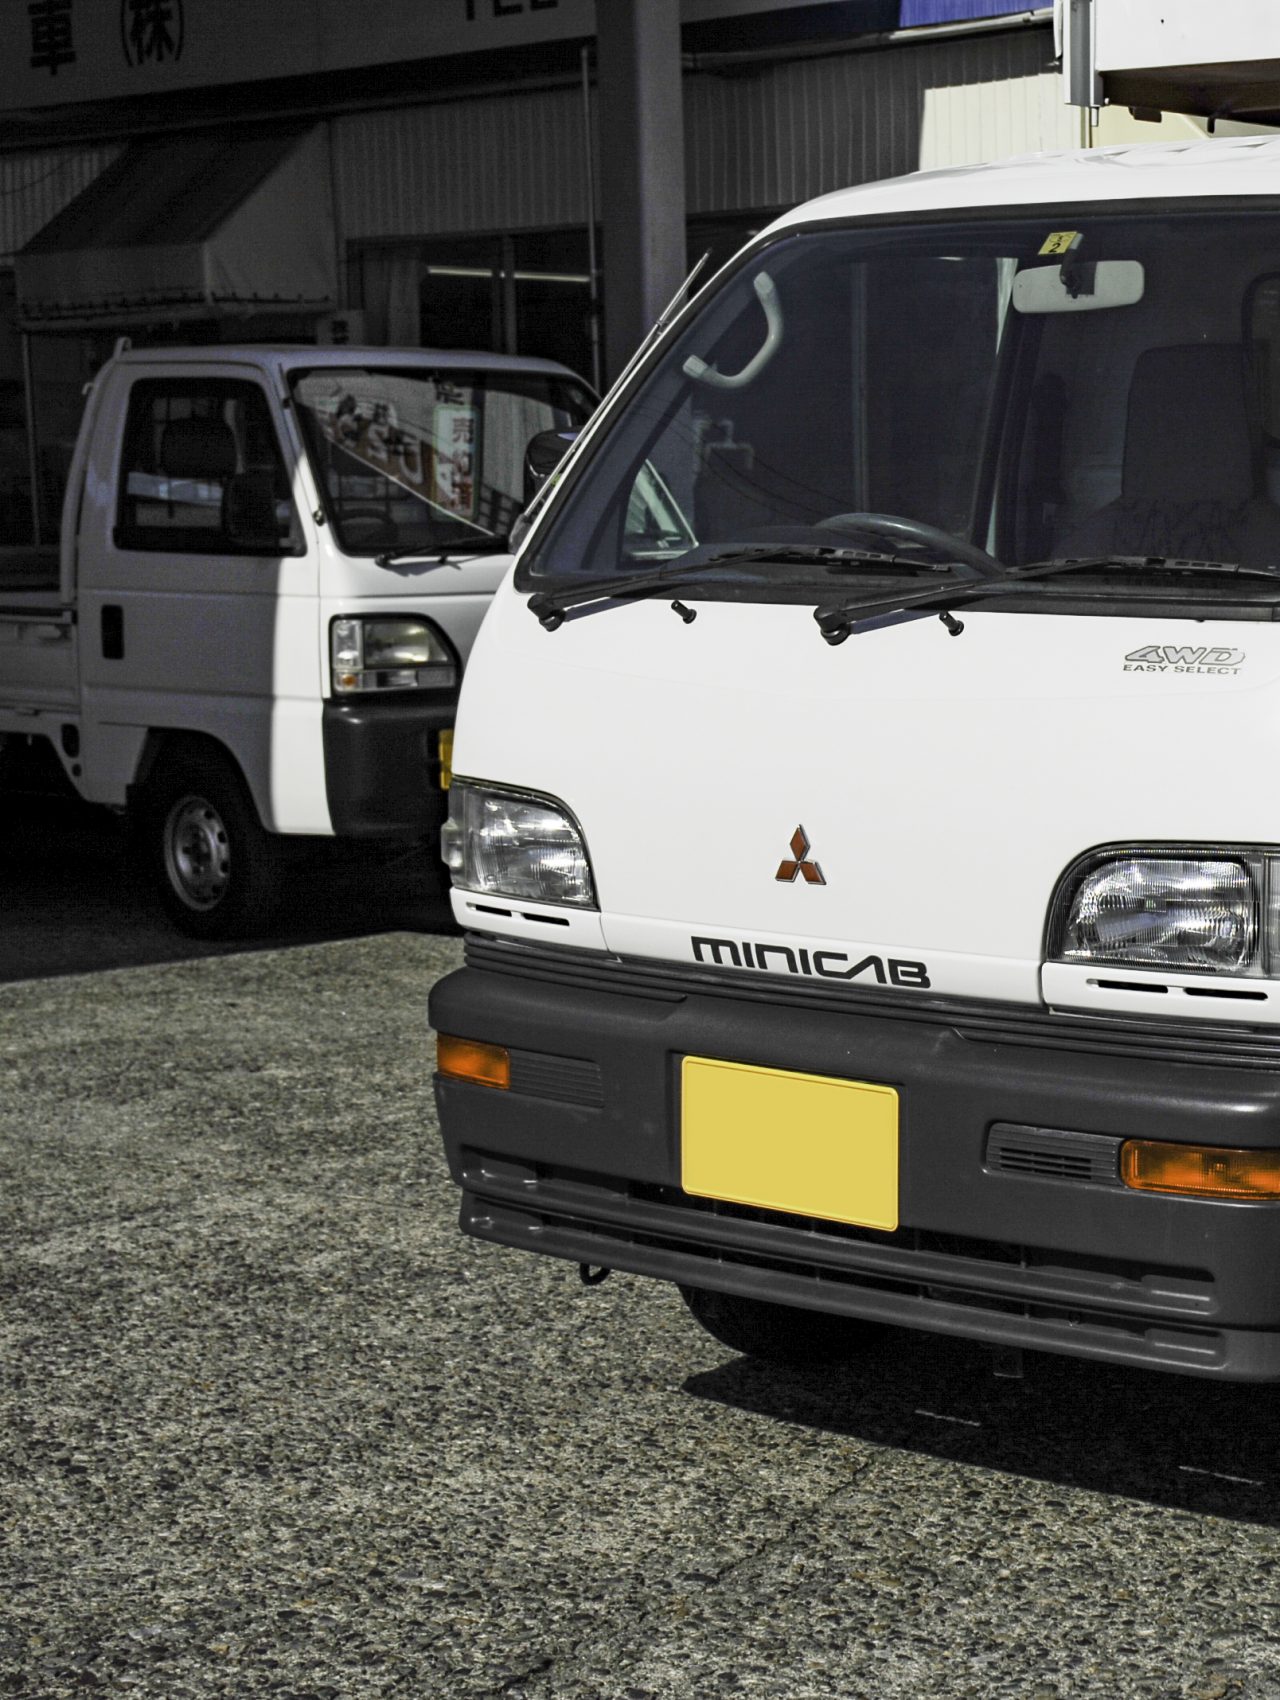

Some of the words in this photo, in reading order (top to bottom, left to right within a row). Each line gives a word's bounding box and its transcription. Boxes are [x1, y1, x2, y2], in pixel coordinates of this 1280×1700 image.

[1124, 645, 1247, 666] 4WD
[1122, 664, 1168, 673] EASY
[1173, 665, 1242, 676] SELECT
[690, 935, 932, 989] MINICAB
